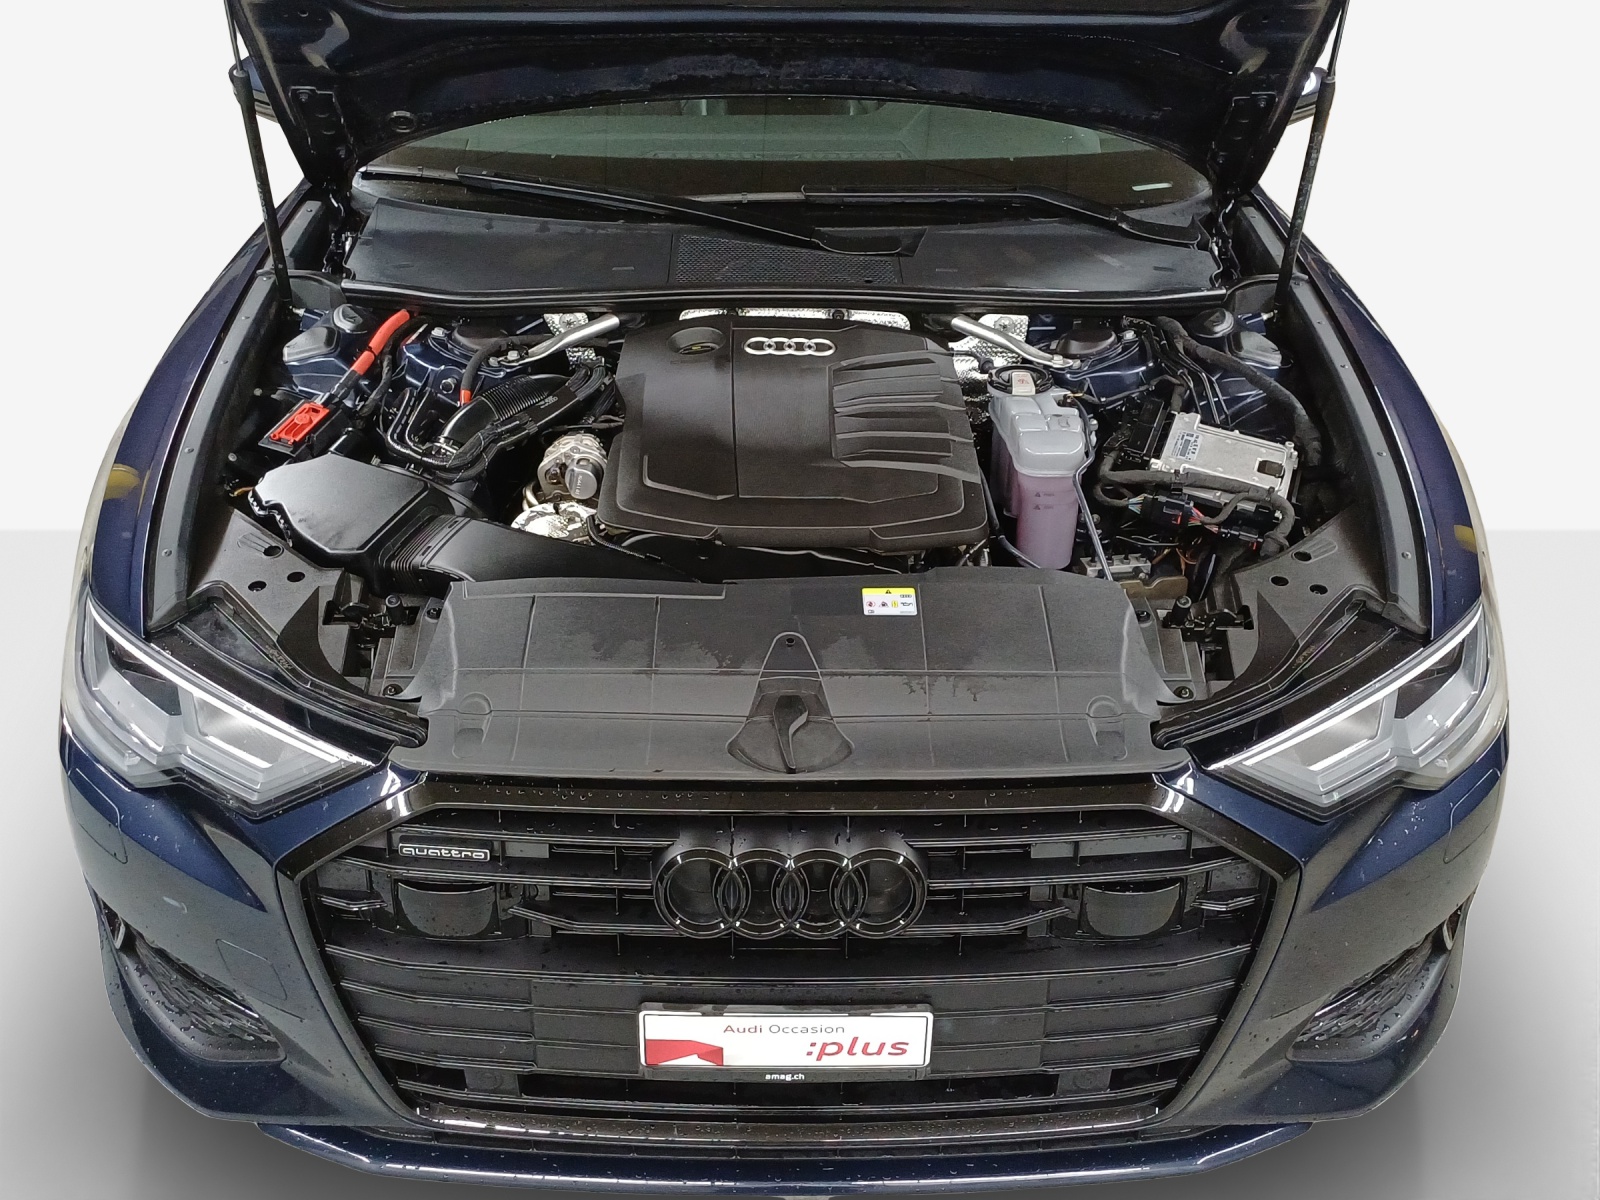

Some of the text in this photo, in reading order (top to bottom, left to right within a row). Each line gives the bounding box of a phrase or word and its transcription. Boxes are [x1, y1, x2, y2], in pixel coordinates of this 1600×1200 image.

[402, 848, 485, 859] quattro
[723, 1024, 845, 1034] Audi Occasion
[765, 1073, 805, 1081] amag.ch
